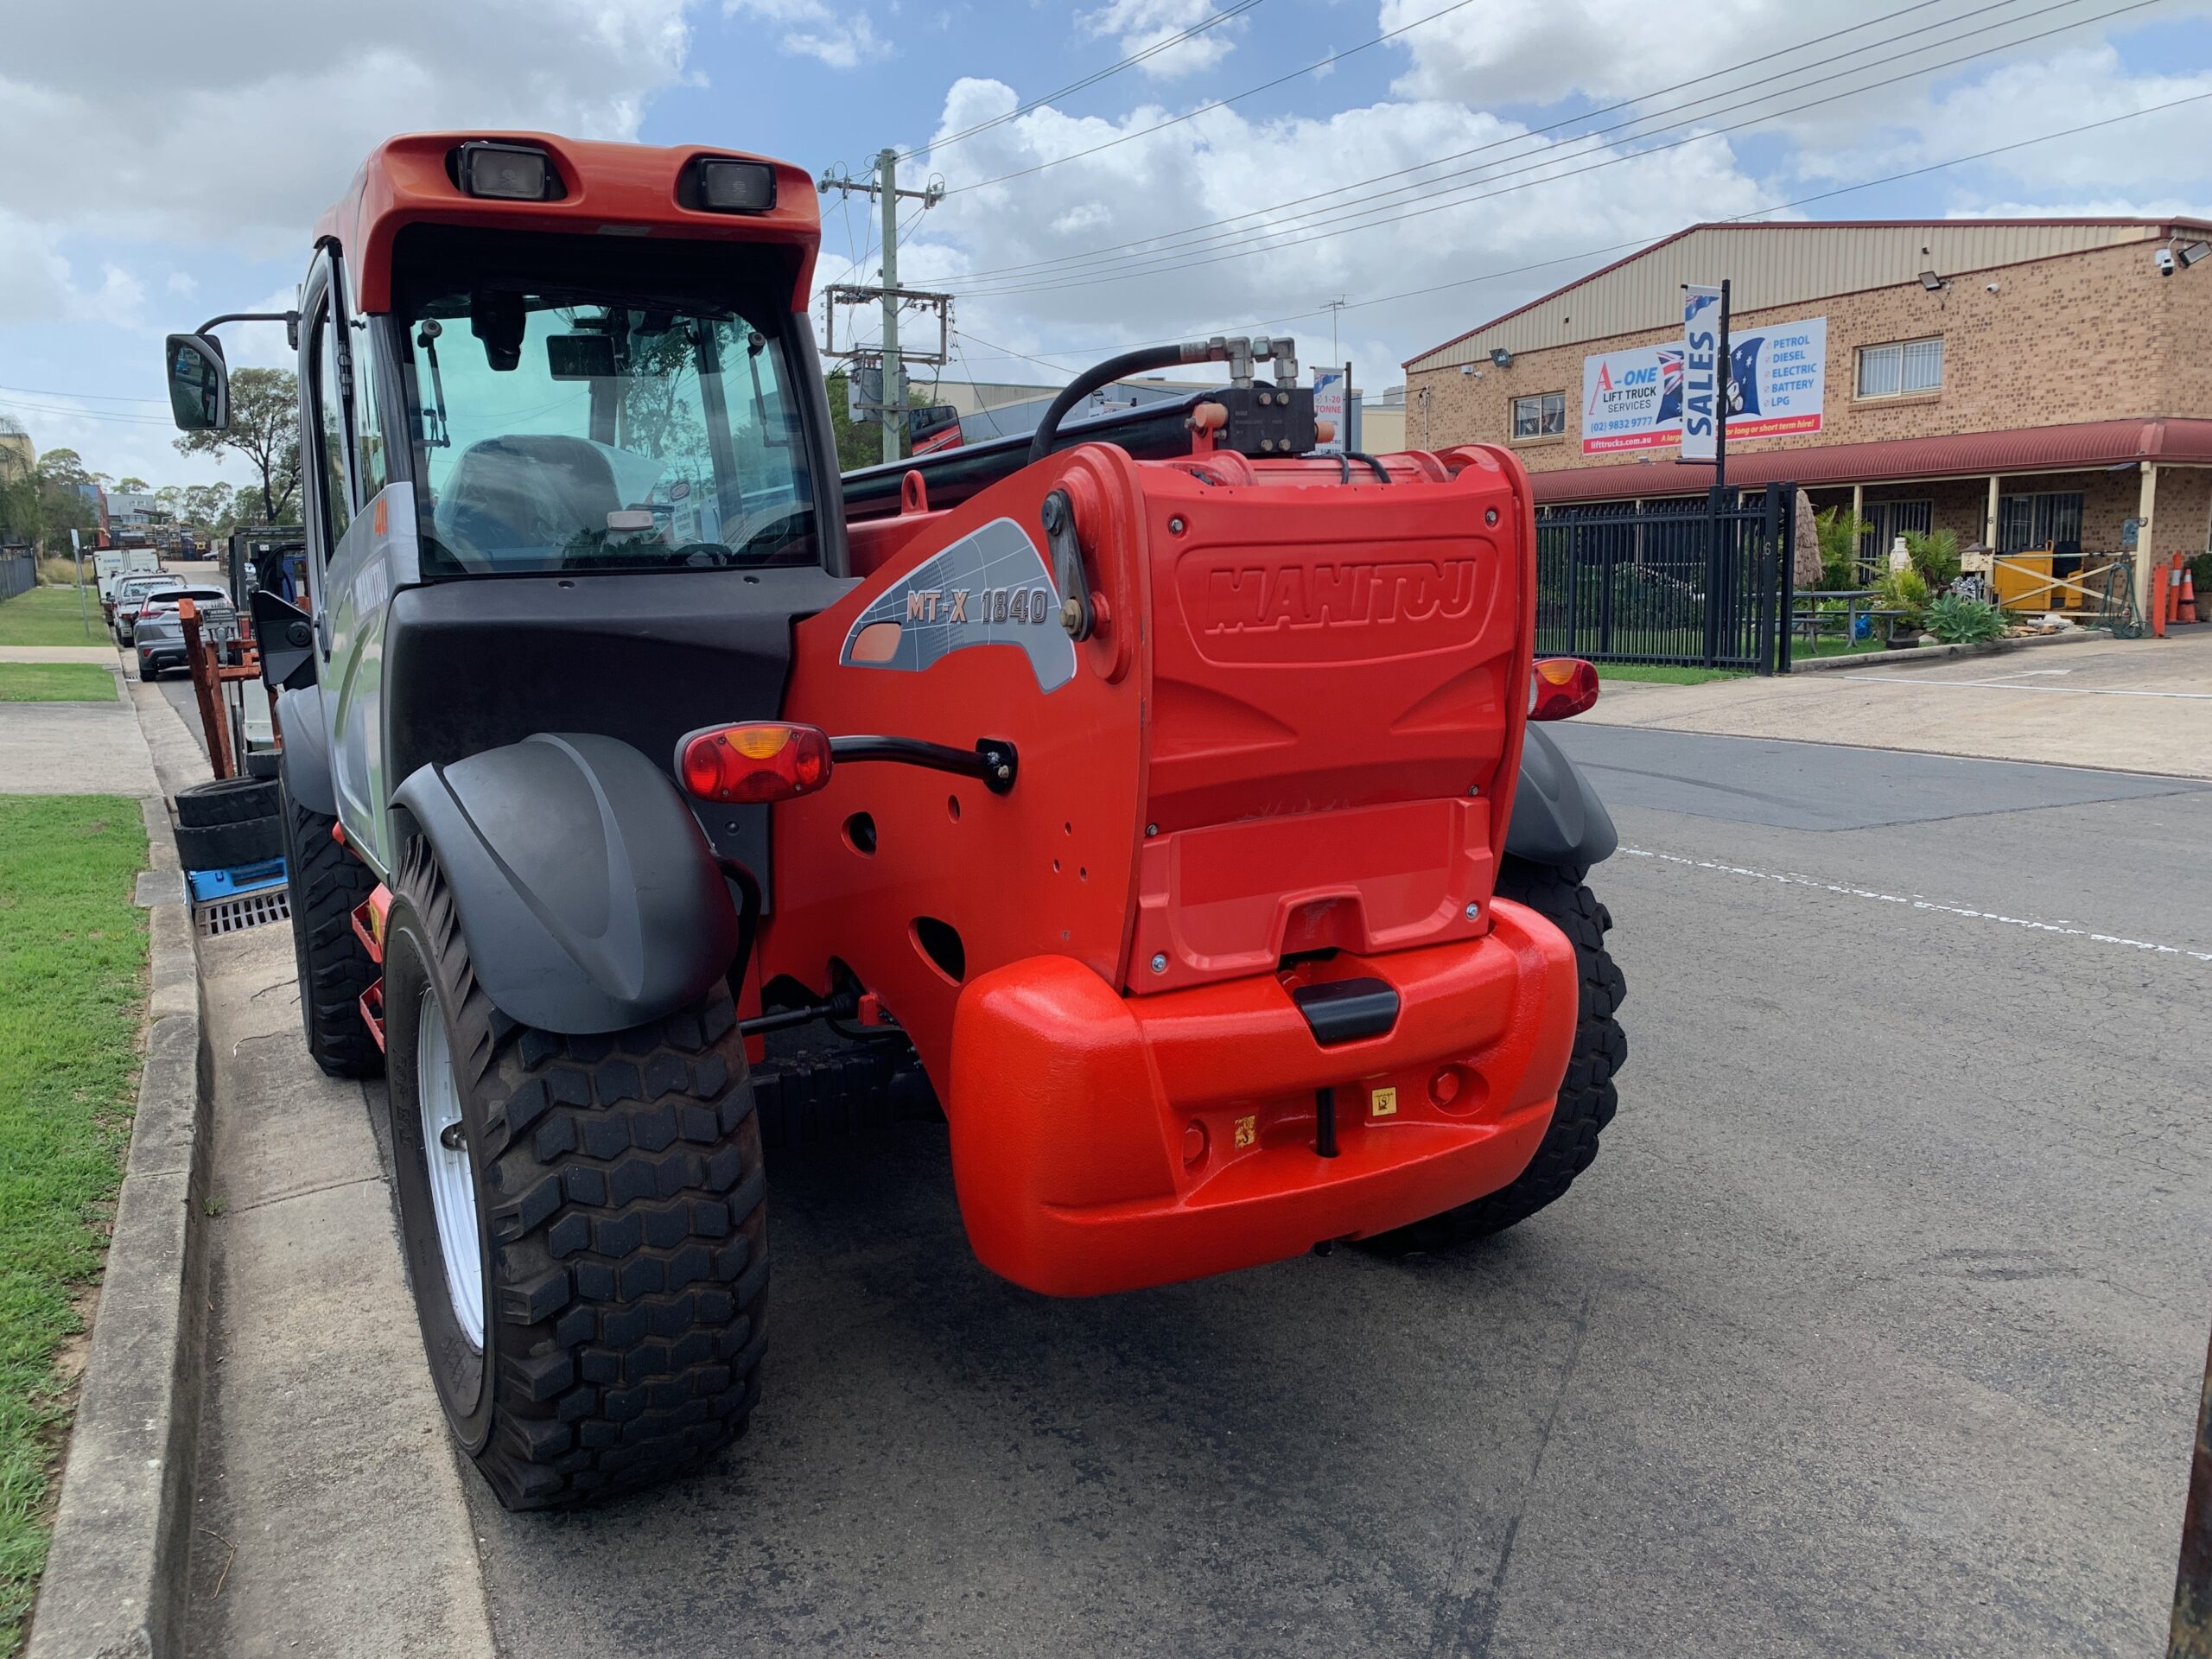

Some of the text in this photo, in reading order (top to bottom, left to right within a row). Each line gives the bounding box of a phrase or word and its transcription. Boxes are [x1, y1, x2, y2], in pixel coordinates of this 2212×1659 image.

[1773, 335, 1810, 349] PETROL
[1772, 351, 1806, 364] DIESEL
[1771, 363, 1817, 378] ELECTRIC
[1687, 332, 1714, 436] SALES
[1771, 378, 1815, 393] BATTERY
[1325, 395, 1341, 404] 1-20
[1604, 386, 1656, 403] LIFT TRUCK
[1770, 397, 1790, 407] LPG
[1315, 404, 1342, 414] TONNE
[1608, 399, 1651, 413] SERVICES
[1591, 416, 1653, 433] (02) 9832 9777
[1734, 427, 1750, 435] long
[1759, 423, 1778, 432] short
[1779, 422, 1796, 430] term
[1797, 419, 1815, 429] hire!
[1591, 437, 1652, 449] lifttrucks.com.au
[355, 557, 389, 616] MANITOU
[1204, 556, 1478, 635] MANITOU
[906, 587, 1048, 624] MT-X 1840
